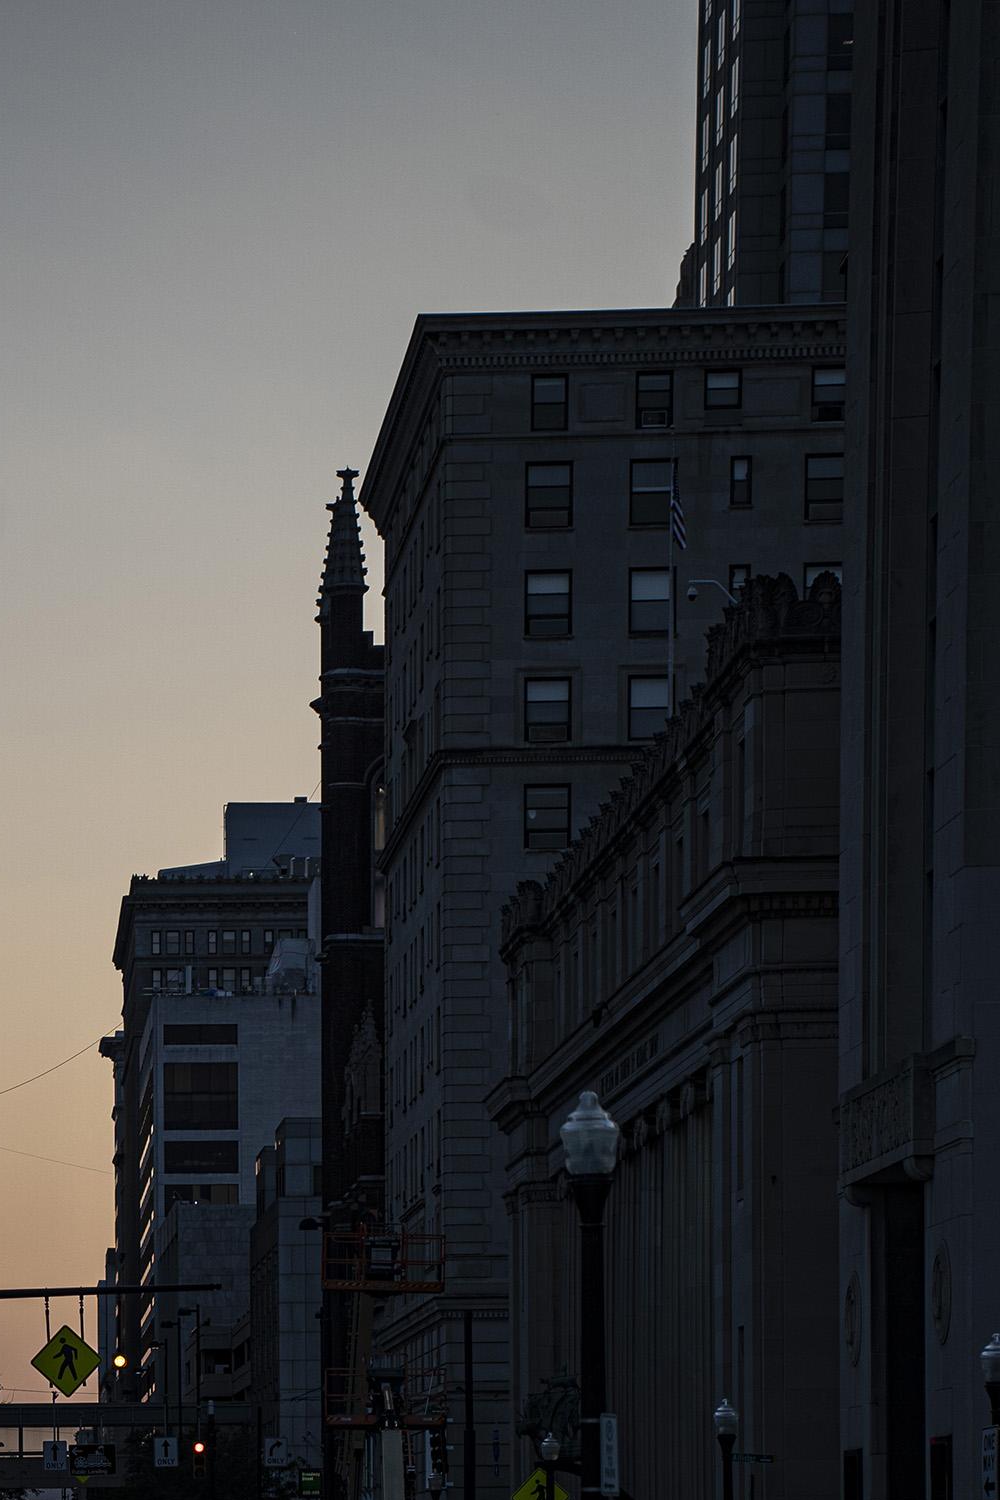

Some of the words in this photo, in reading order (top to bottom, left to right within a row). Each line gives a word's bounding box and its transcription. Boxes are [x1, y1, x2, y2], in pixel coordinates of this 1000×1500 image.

[983, 1433, 995, 1451] ONE
[732, 1454, 757, 1463] Allister
[983, 1453, 996, 1472] WAY
